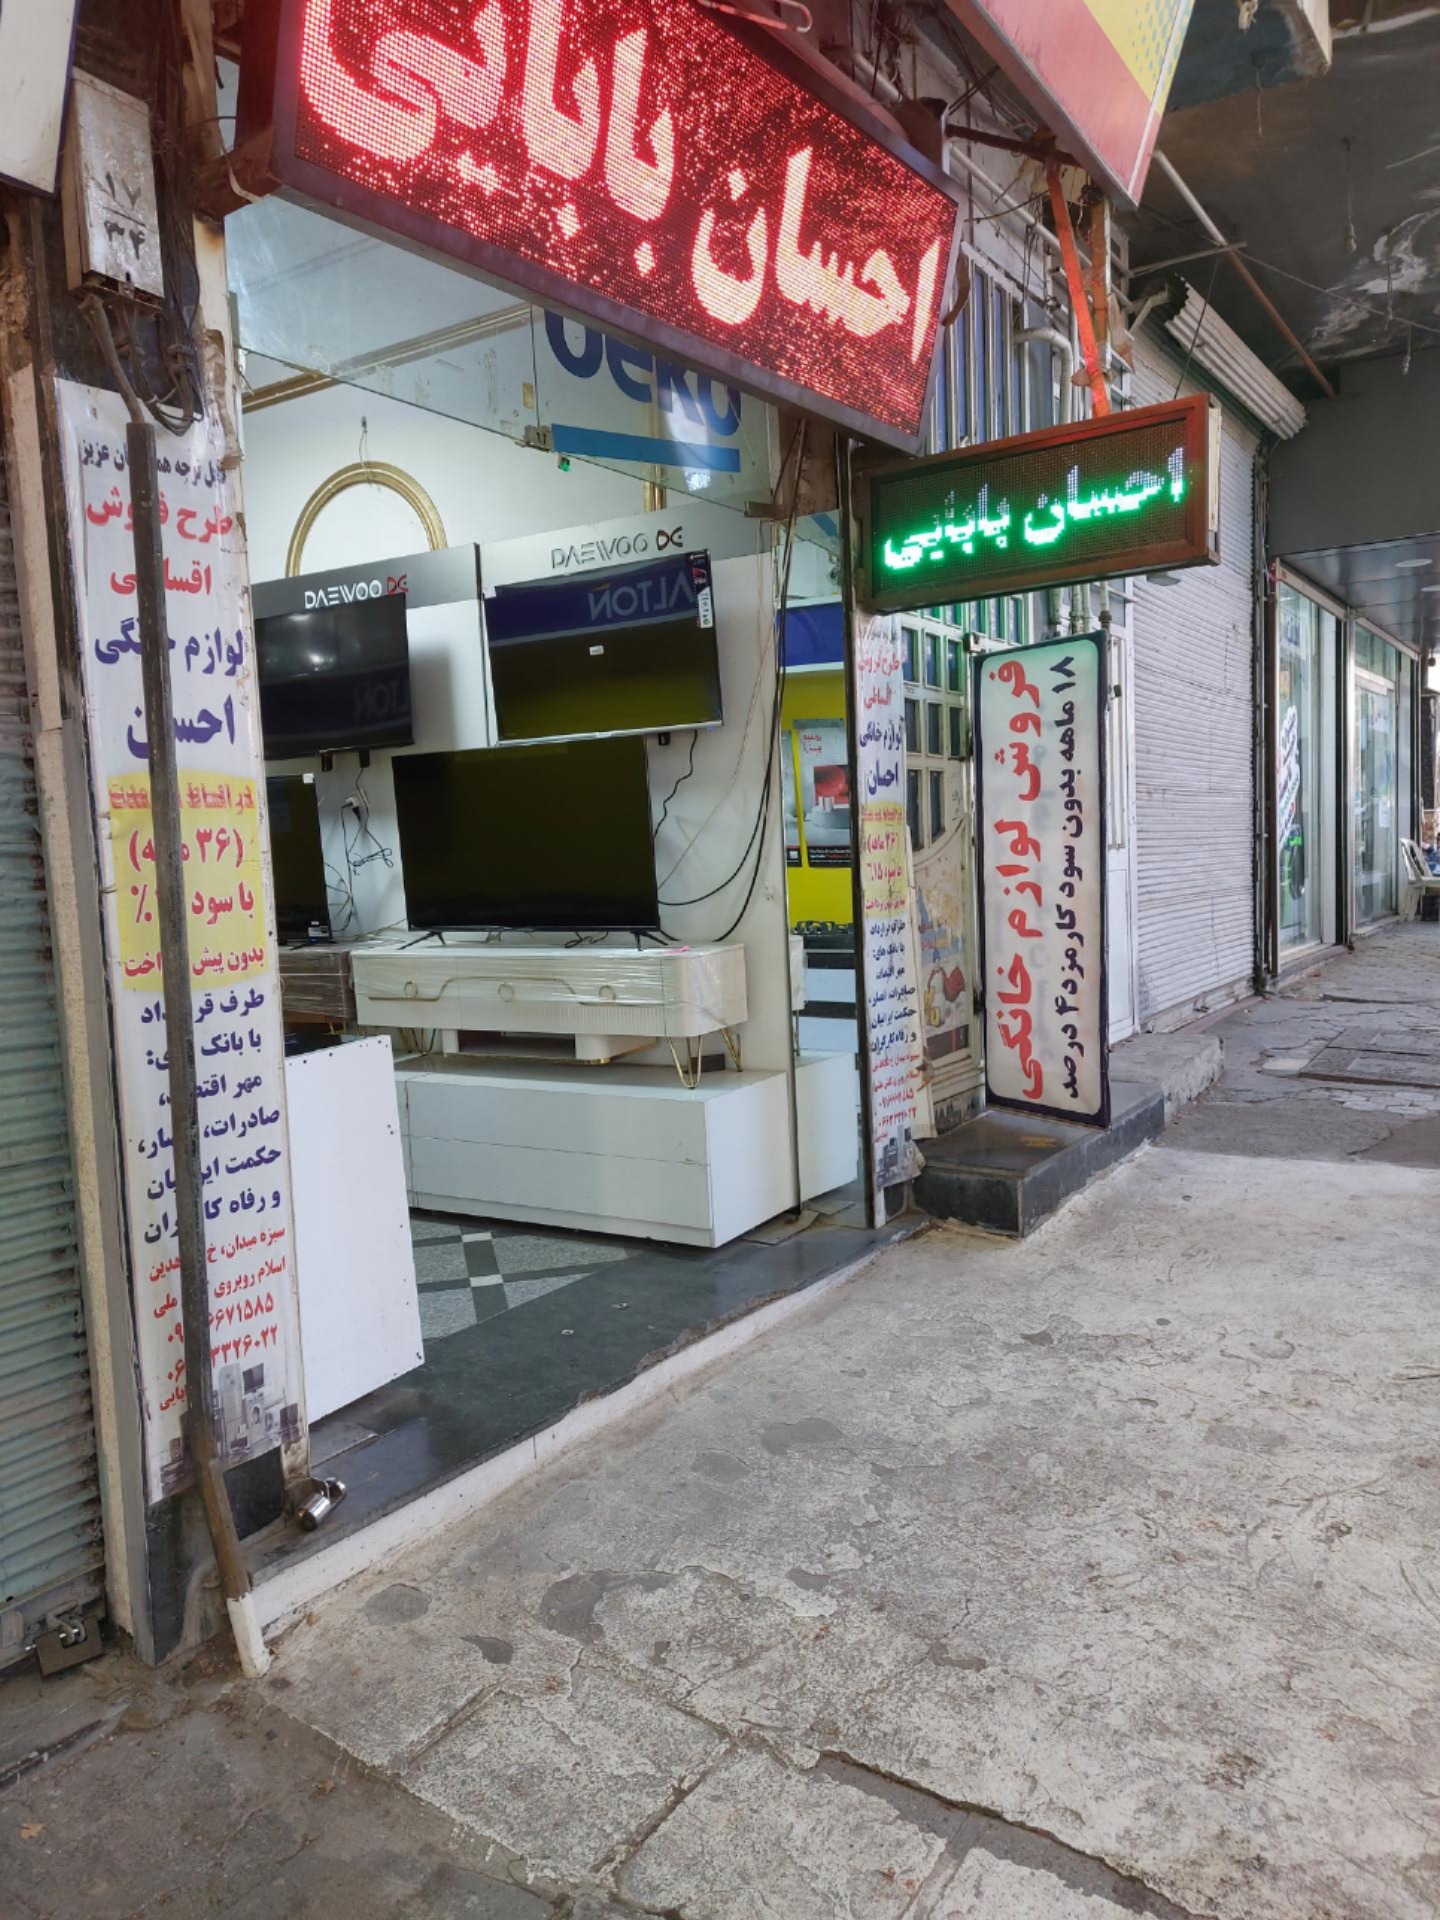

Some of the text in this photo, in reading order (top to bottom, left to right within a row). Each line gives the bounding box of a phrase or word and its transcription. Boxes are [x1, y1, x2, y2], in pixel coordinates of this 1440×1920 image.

[691, 146, 942, 365] احسان
[175, 505, 233, 544] طرح
[884, 447, 1184, 570] احسان بابایی
[551, 532, 649, 569] DAEWOO
[110, 556, 212, 596] اقسای
[304, 579, 382, 609] DAEWOO
[184, 626, 245, 677] لوازم
[126, 693, 236, 761] احسن
[1054, 700, 1075, 762] ماهه
[1060, 768, 1083, 839] بدون
[989, 659, 1043, 1100] فروش لوازم خانگی
[1058, 845, 1083, 898] سود
[191, 890, 233, 926] سود
[237, 881, 255, 919] با
[191, 946, 223, 977] پیش
[227, 946, 264, 973] بدون
[219, 987, 264, 1017] طرف
[200, 1031, 244, 1057] بانک
[249, 1028, 262, 1053] با
[1061, 1023, 1085, 1098] درصد
[233, 1072, 263, 1099] مهر
[202, 1105, 281, 1139] صادرات،
[225, 1145, 282, 1175] حکمت
[229, 1187, 266, 1214] رفاه
[271, 1187, 282, 1209] و
[259, 1226, 286, 1247] سبزه
[154, 1255, 286, 1319] اسلام روبروی ملی
